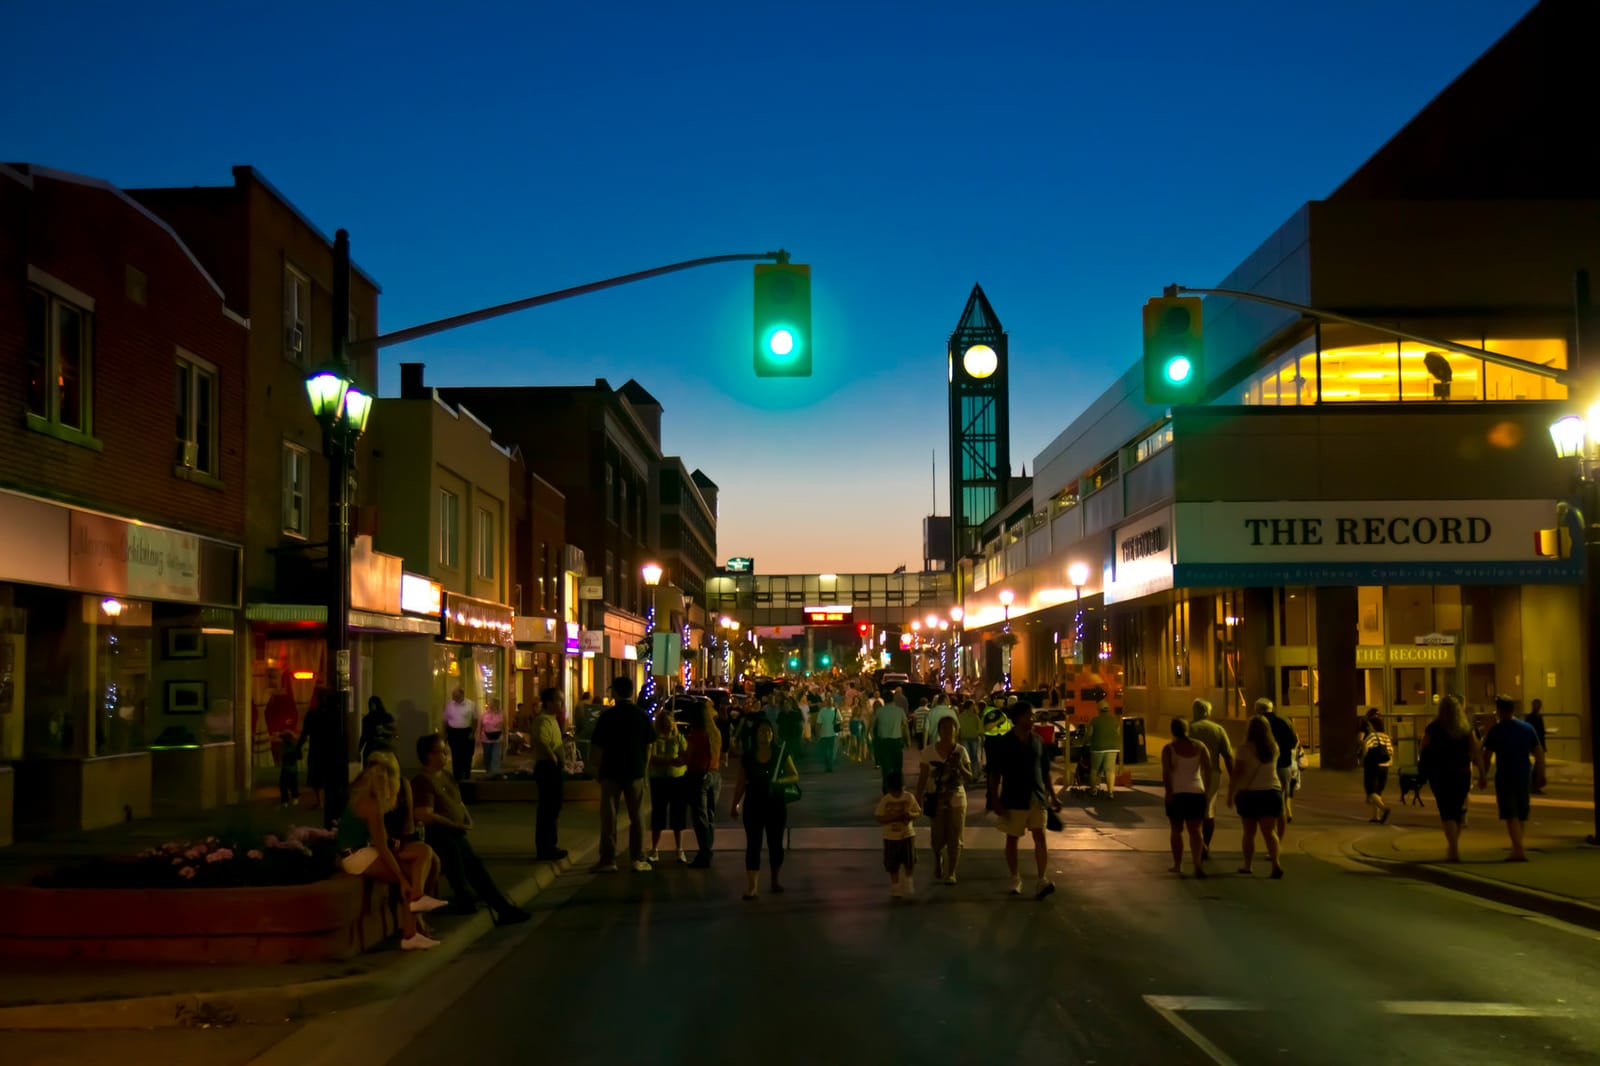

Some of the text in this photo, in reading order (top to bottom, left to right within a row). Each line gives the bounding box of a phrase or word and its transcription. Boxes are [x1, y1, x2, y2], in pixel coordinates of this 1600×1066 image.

[1244, 517, 1491, 546] THE RECORD
[1356, 648, 1448, 661] THE RECORD
